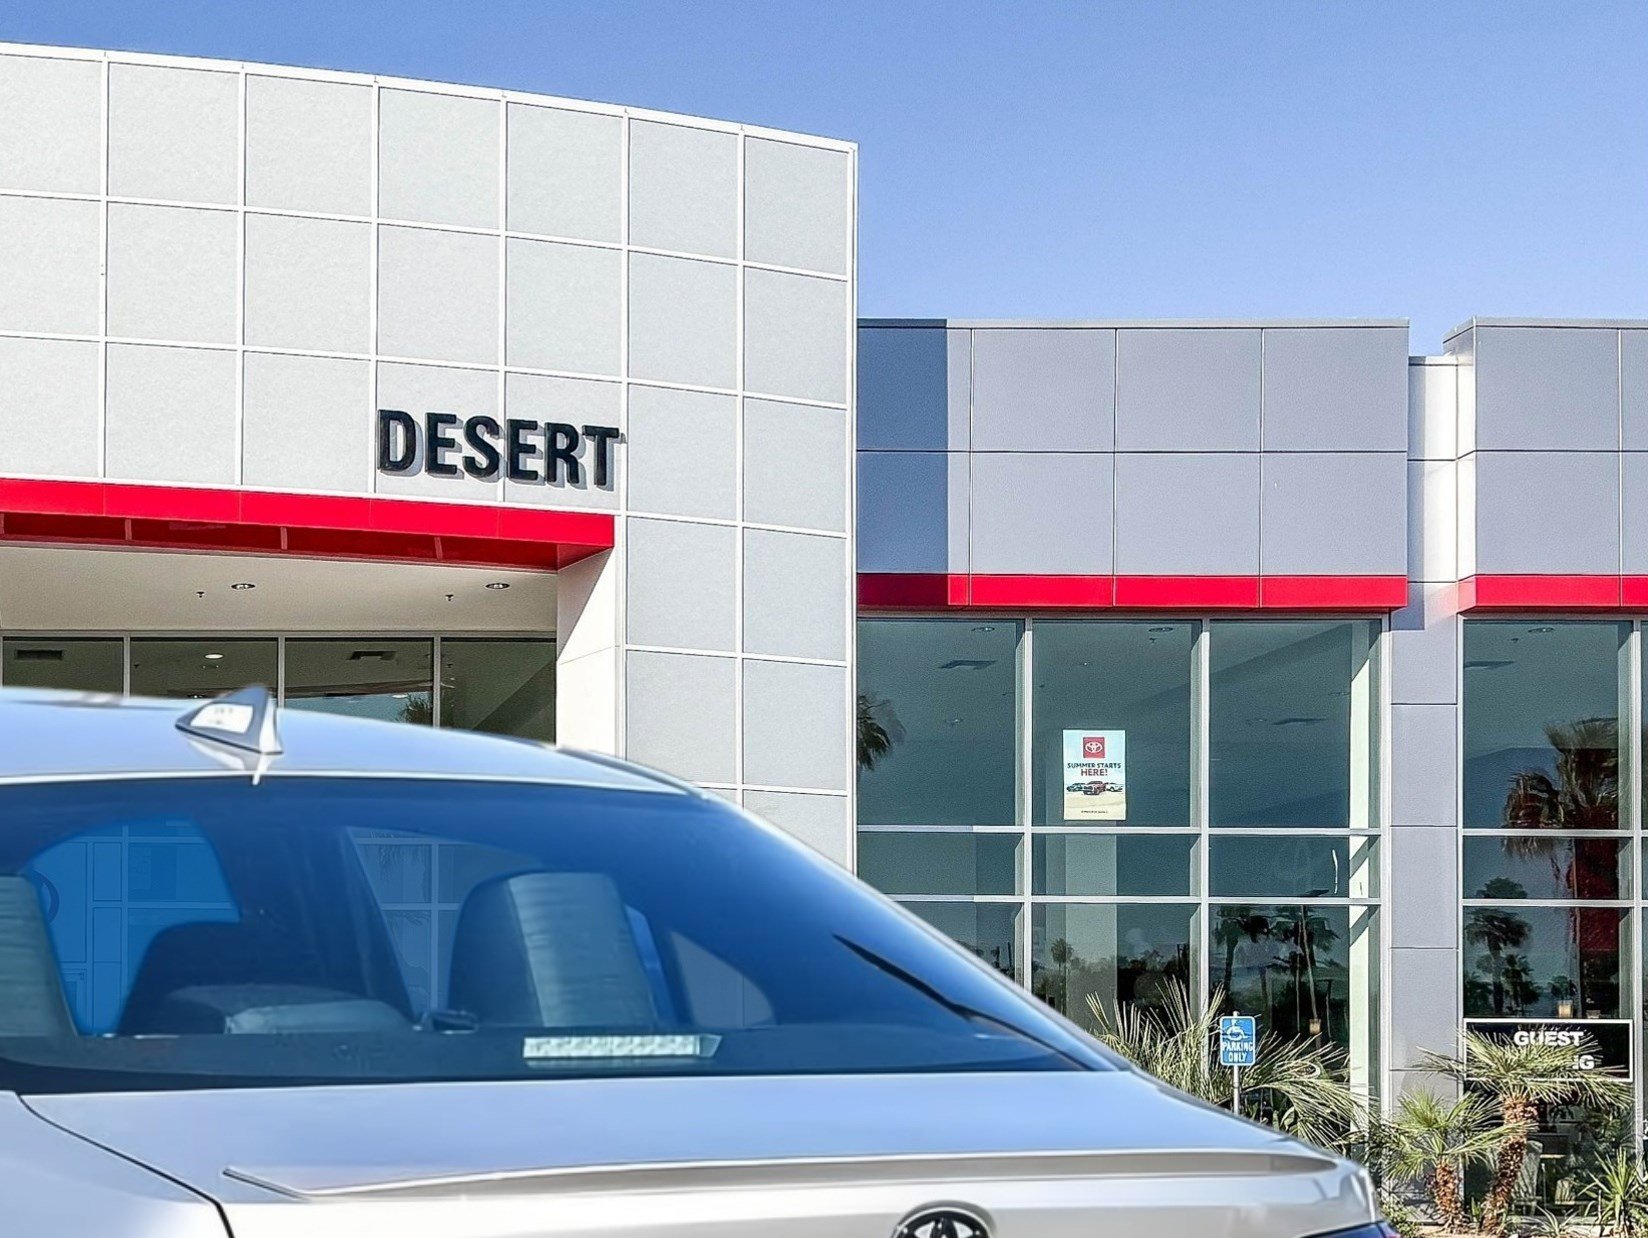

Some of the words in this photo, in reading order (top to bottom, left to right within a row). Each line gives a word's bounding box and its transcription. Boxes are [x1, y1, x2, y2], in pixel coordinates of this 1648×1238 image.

[376, 408, 621, 488] DESERT
[1081, 768, 1108, 777] HERE!
[1513, 1030, 1584, 1047] GUEST
[1222, 1041, 1253, 1051] PARKING
[1228, 1051, 1247, 1062] ONLY
